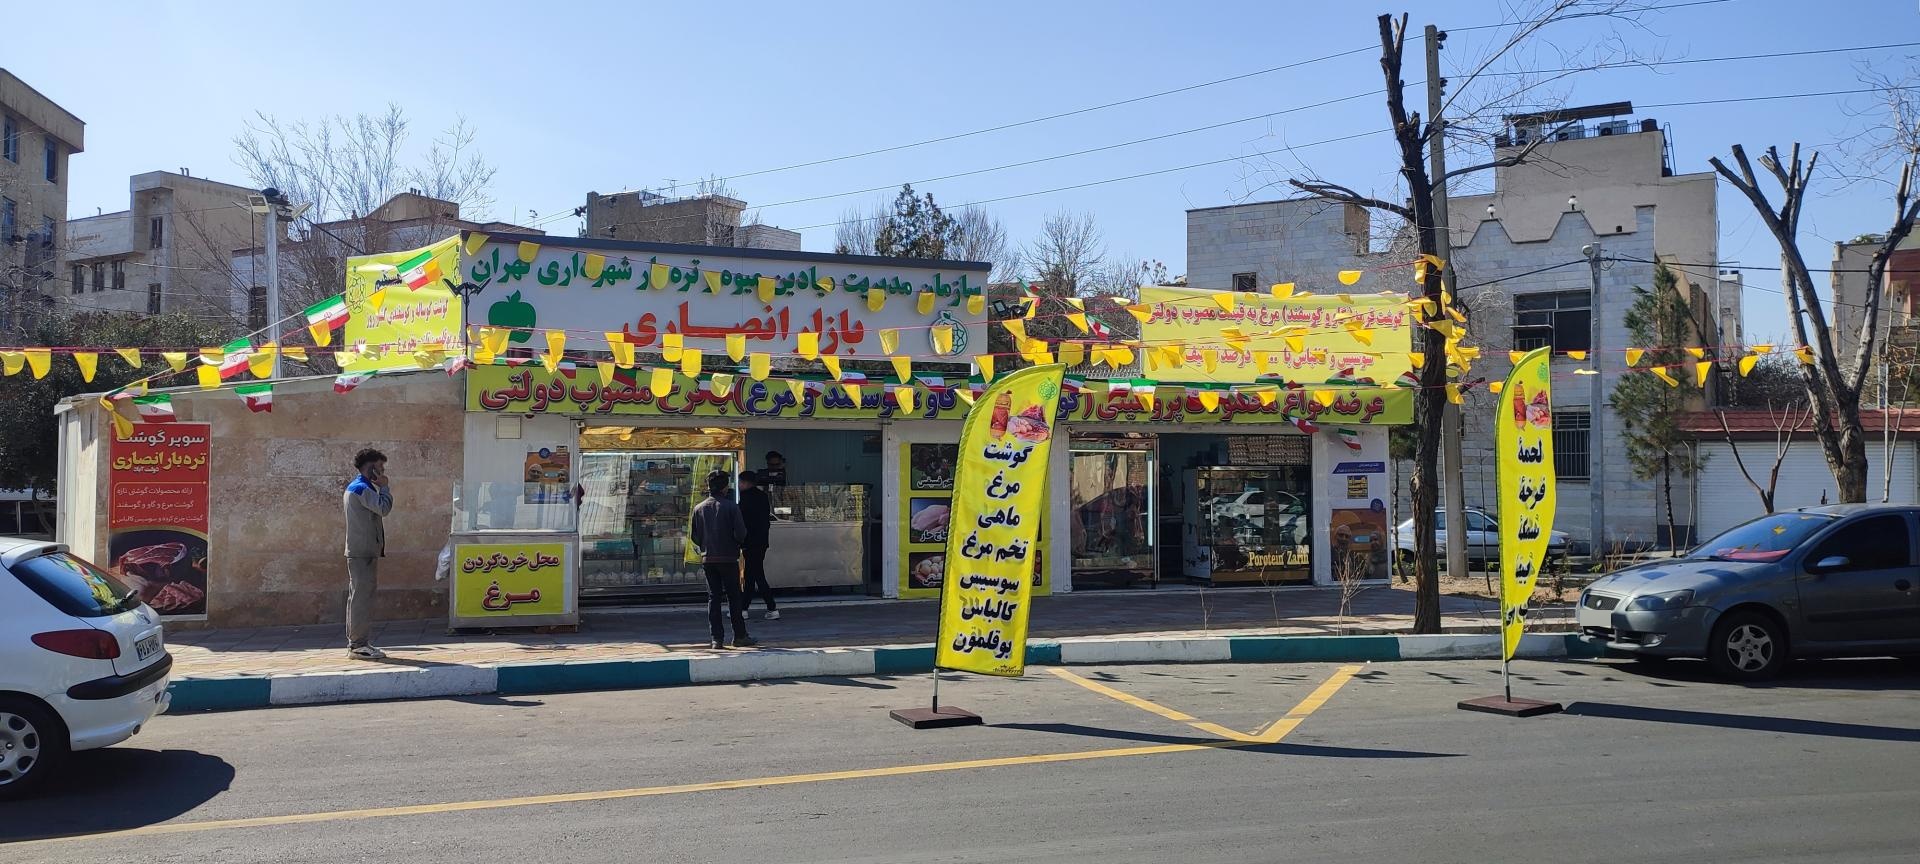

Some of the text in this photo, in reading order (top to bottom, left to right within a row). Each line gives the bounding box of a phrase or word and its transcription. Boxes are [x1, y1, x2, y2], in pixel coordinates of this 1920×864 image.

[537, 252, 633, 288] شهراری
[480, 369, 567, 412] دولتی
[168, 434, 205, 447] سوپر
[112, 450, 164, 470] انصاری
[982, 443, 1034, 469] گوشت
[149, 486, 180, 496] محصولات
[986, 470, 1021, 499] مرغ
[977, 505, 1021, 529] ماهی
[961, 530, 1029, 562] تخم مرغ
[463, 551, 560, 573] محل خرد کردن
[1248, 550, 1285, 568] Porotein
[482, 581, 541, 611] مرغ
[959, 573, 1021, 595] سوسیس
[961, 597, 1018, 622] کالباس
[952, 629, 1013, 660] بوقلمون
